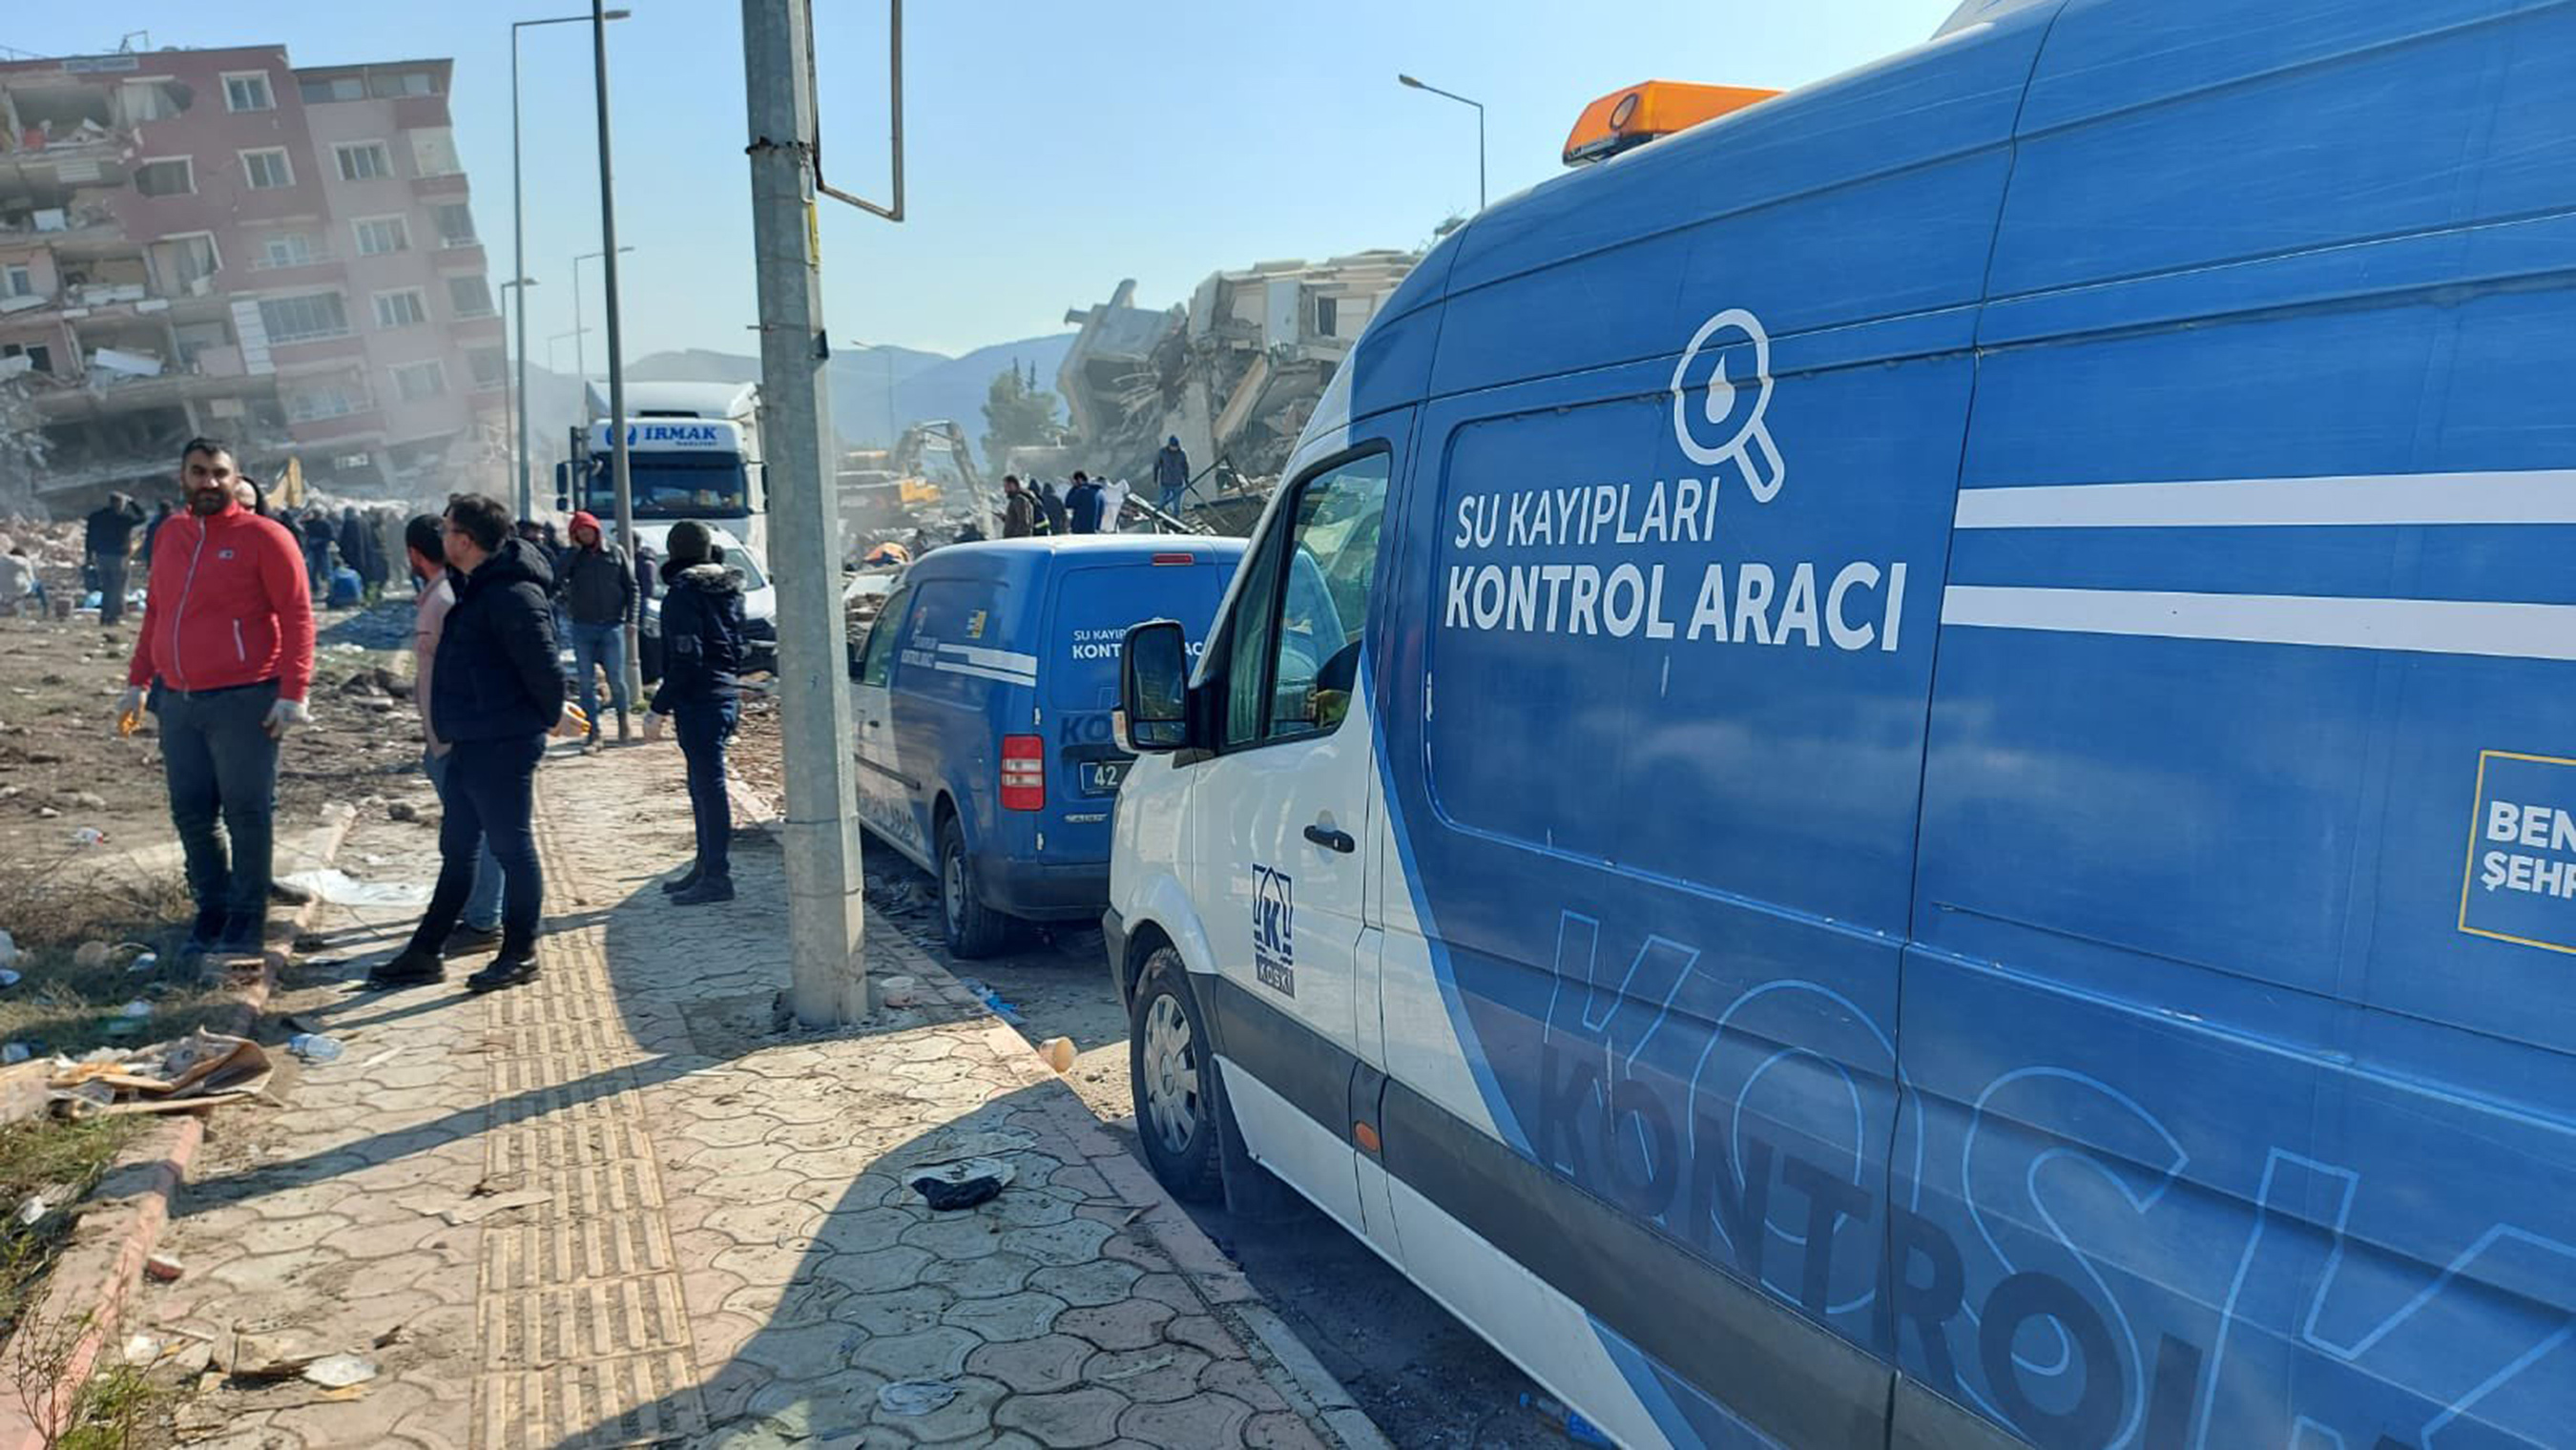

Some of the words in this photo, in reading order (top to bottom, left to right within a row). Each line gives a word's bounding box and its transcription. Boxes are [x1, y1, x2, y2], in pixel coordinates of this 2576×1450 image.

[645, 426, 717, 440] IRMAK
[1455, 493, 1500, 549] SU
[1506, 477, 1719, 547] KAYIPLARI
[1445, 564, 1674, 639] KONTROL
[1687, 562, 1907, 652] ARACI
[1073, 630, 1091, 641] SU
[1093, 765, 1118, 786] 42
